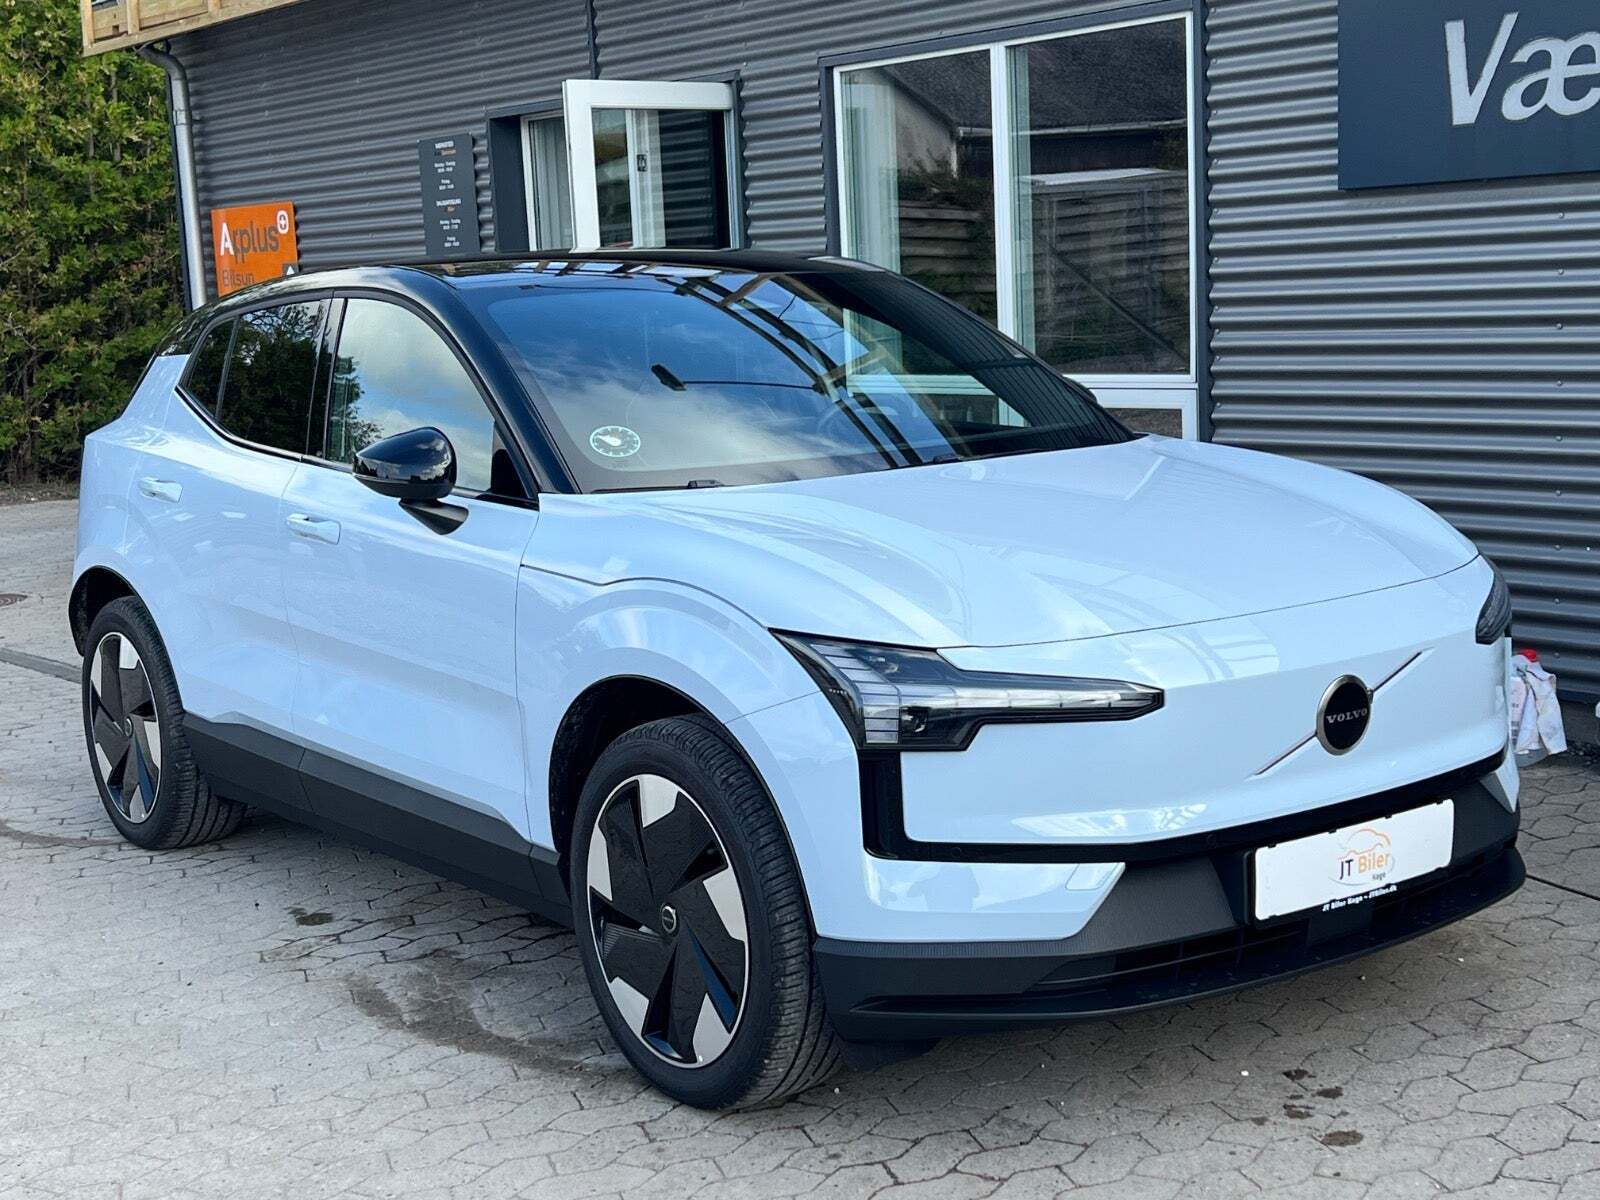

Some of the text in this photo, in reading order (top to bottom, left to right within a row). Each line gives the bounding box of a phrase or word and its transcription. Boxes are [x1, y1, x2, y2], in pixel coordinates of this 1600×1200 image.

[1326, 708, 1367, 723] VOLVO
[1339, 852, 1391, 880] JT Biler
